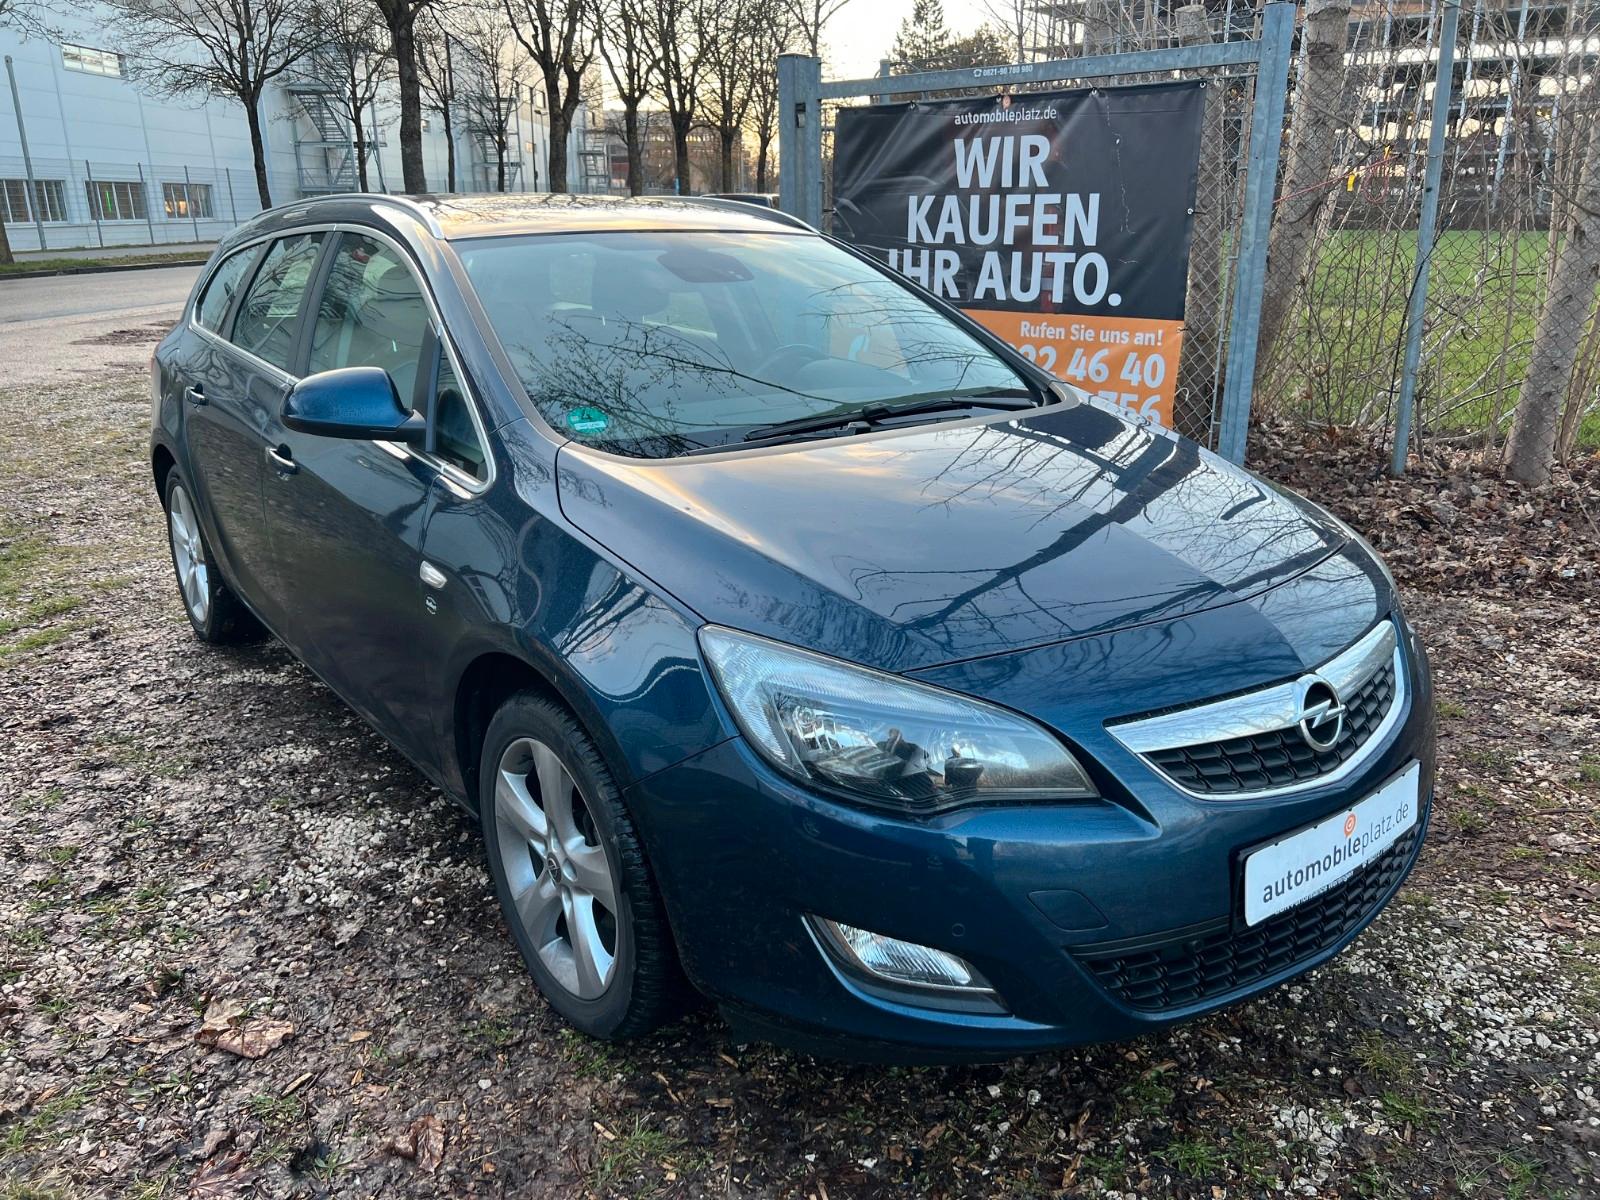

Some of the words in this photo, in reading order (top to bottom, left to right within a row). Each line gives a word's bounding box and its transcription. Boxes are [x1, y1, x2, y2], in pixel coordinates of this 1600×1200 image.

[954, 106, 1057, 125] automobileplatz.de
[954, 134, 1051, 189] WIR
[907, 193, 1100, 247] KAUFEN
[973, 251, 1122, 307] AUTO.
[1020, 320, 1065, 340] Rufen
[1070, 324, 1096, 342] Sie
[1099, 329, 1130, 344] uns
[1134, 329, 1164, 346] an!
[1066, 347, 1111, 384] 46
[1119, 351, 1166, 389] 40
[1262, 800, 1410, 904] automobileplatz.de
